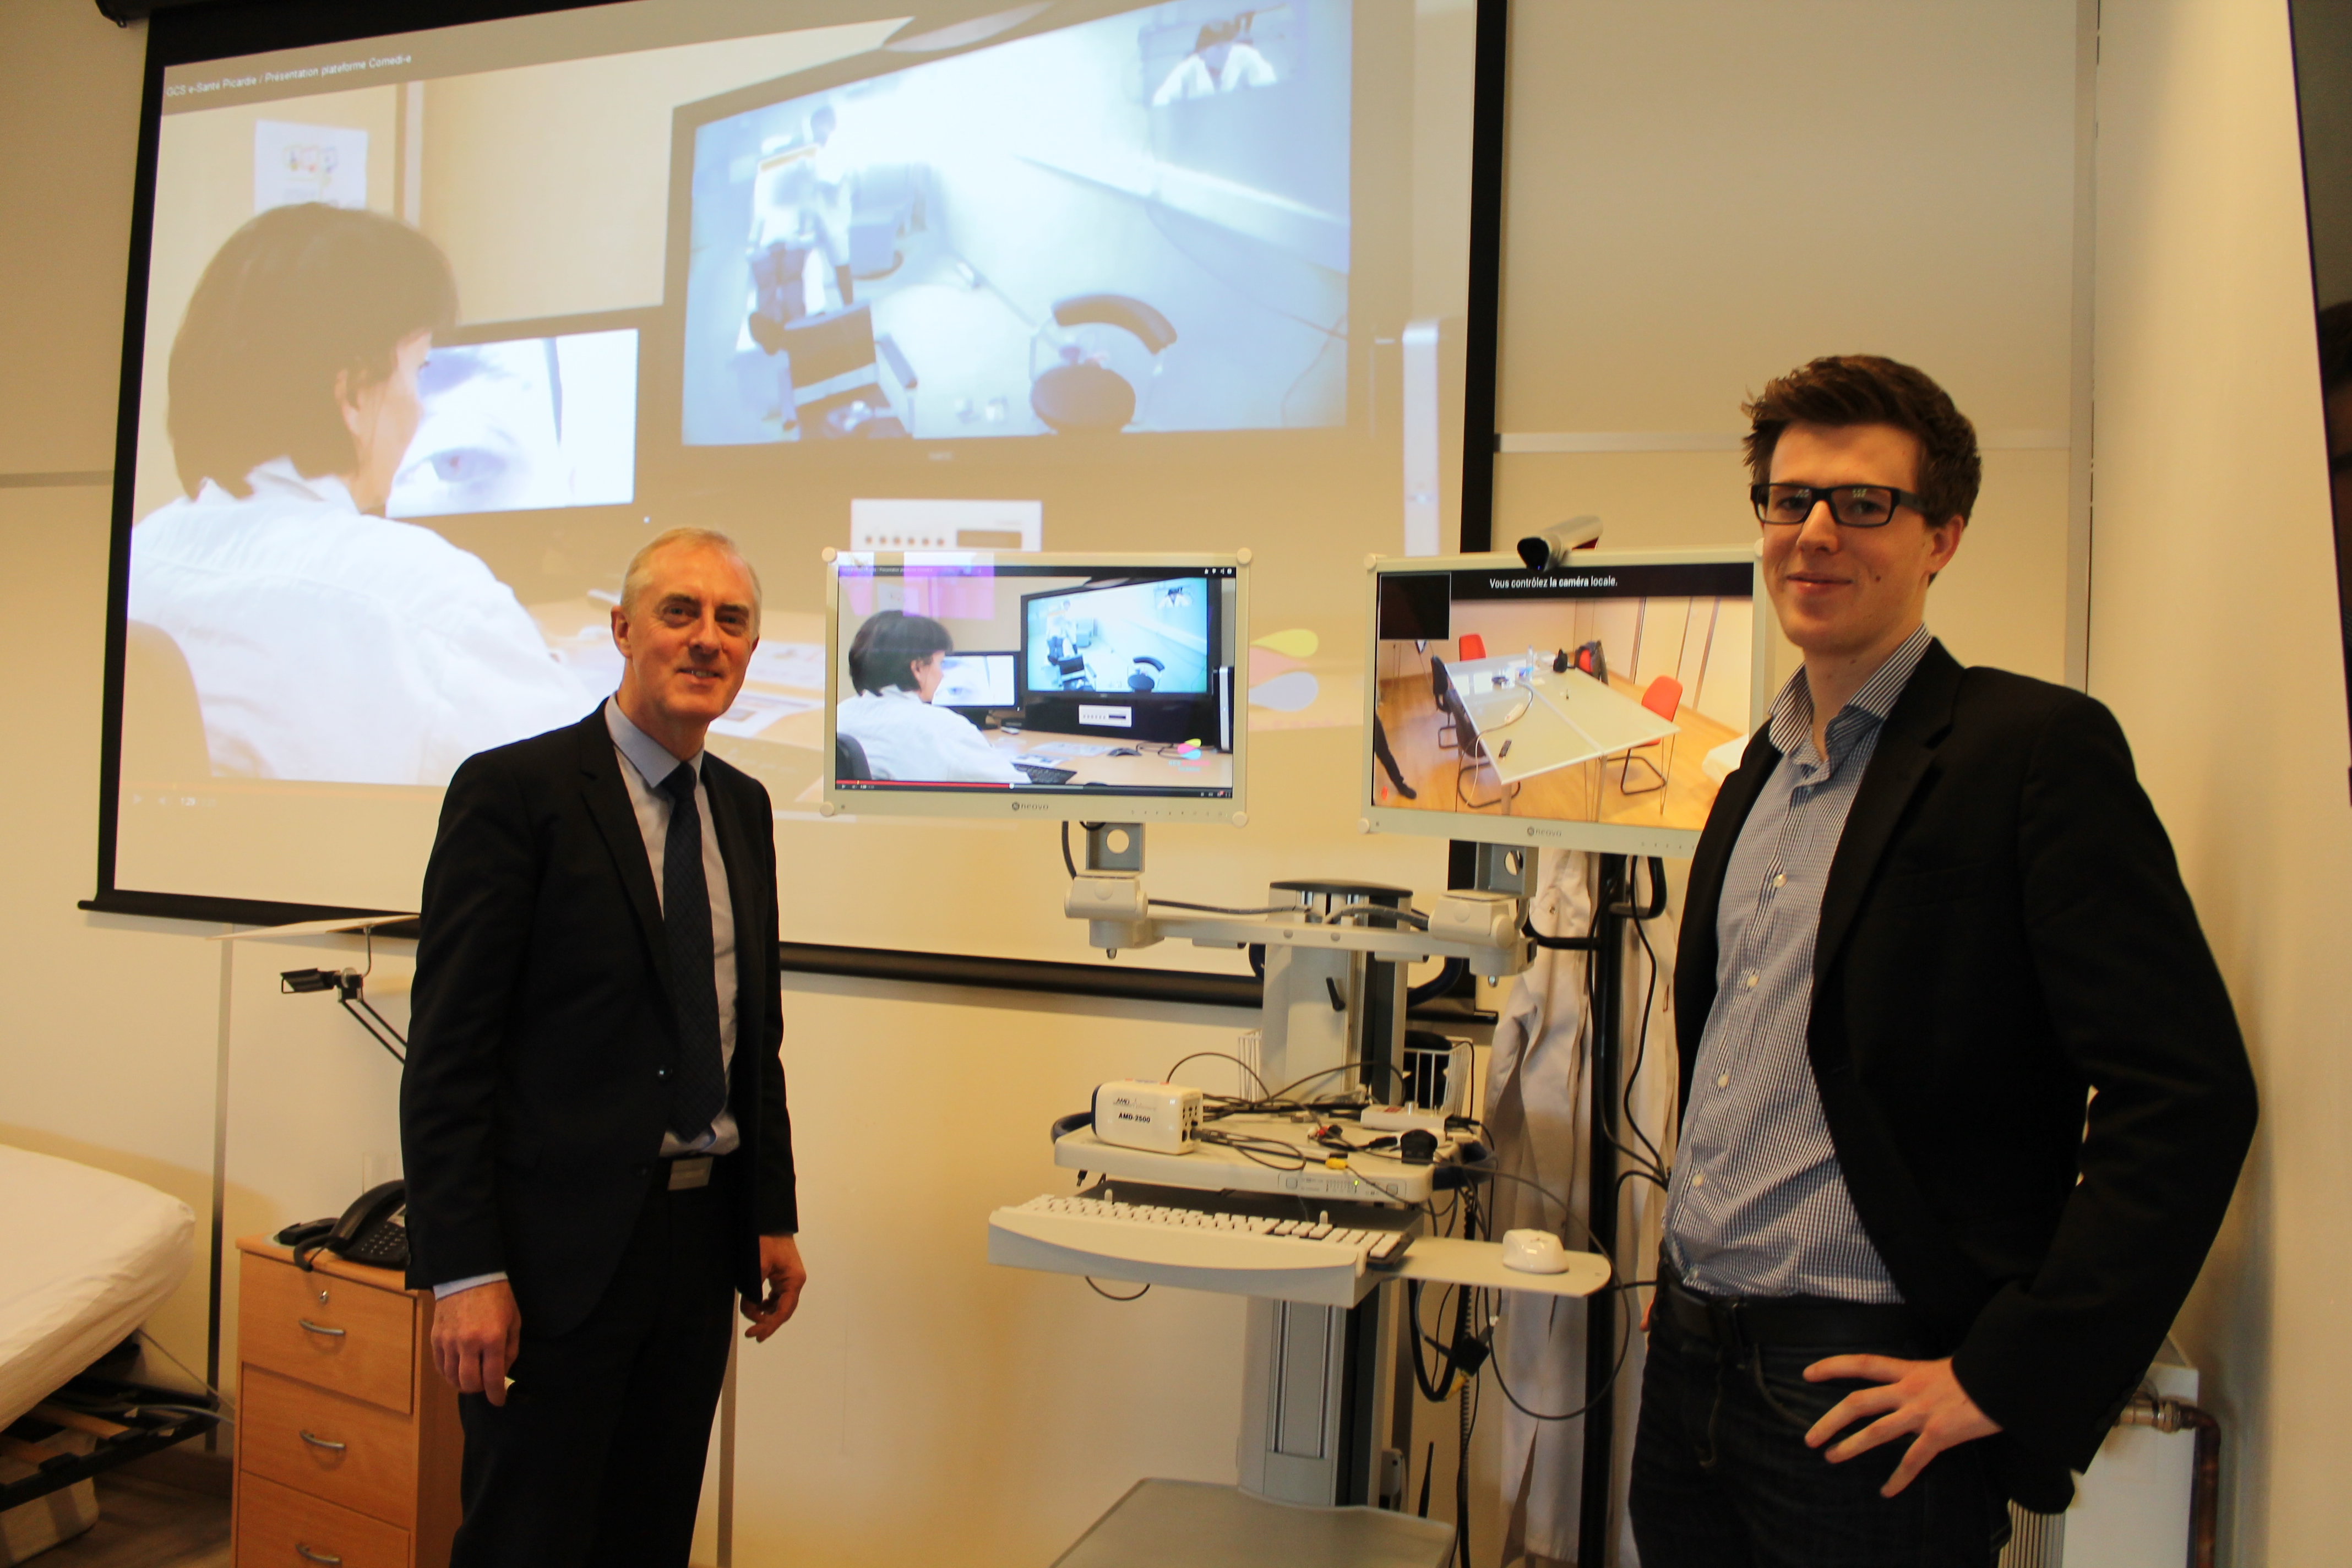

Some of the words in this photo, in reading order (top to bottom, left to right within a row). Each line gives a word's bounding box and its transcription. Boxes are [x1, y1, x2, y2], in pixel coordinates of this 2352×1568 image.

[166, 84, 186, 97] GCS
[222, 76, 257, 89] Picardie
[321, 61, 366, 78] plateforme
[1490, 578, 1509, 589] Vous
[1511, 577, 1548, 588] contrôlez
[1550, 576, 1557, 587] la
[1559, 576, 1589, 587] caméra
[1591, 575, 1618, 587] locale.
[1118, 1112, 1151, 1124] AMD-2500
